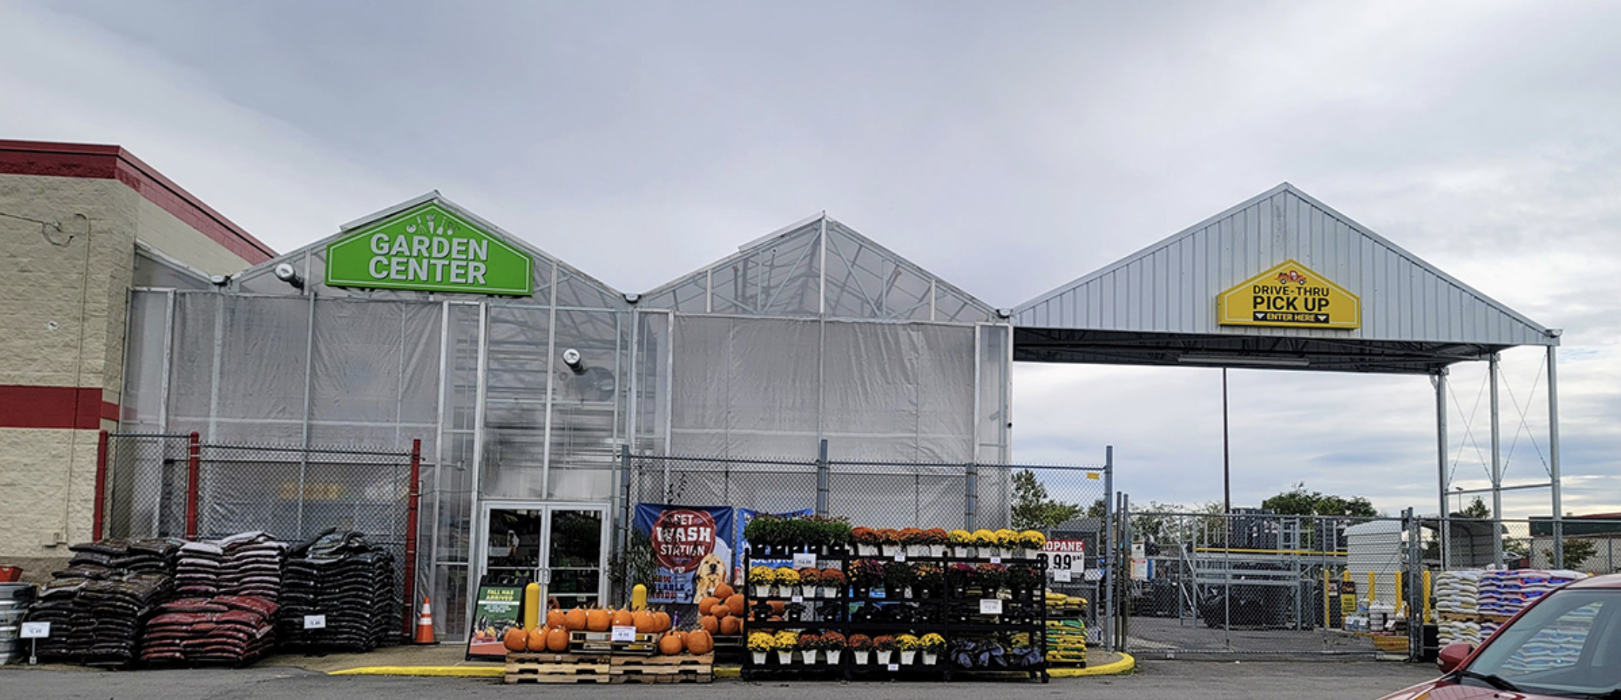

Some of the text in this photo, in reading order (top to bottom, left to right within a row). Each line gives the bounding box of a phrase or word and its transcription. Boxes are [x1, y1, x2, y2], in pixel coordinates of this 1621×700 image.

[370, 233, 488, 261] GARDEN
[368, 256, 487, 285] CENTER
[1253, 285, 1329, 297] DRIVE-THRU
[1253, 295, 1329, 312] PICK UP
[1266, 312, 1315, 322] ENTER HERE
[656, 527, 711, 543] WASH
[1043, 540, 1083, 551] OPANE
